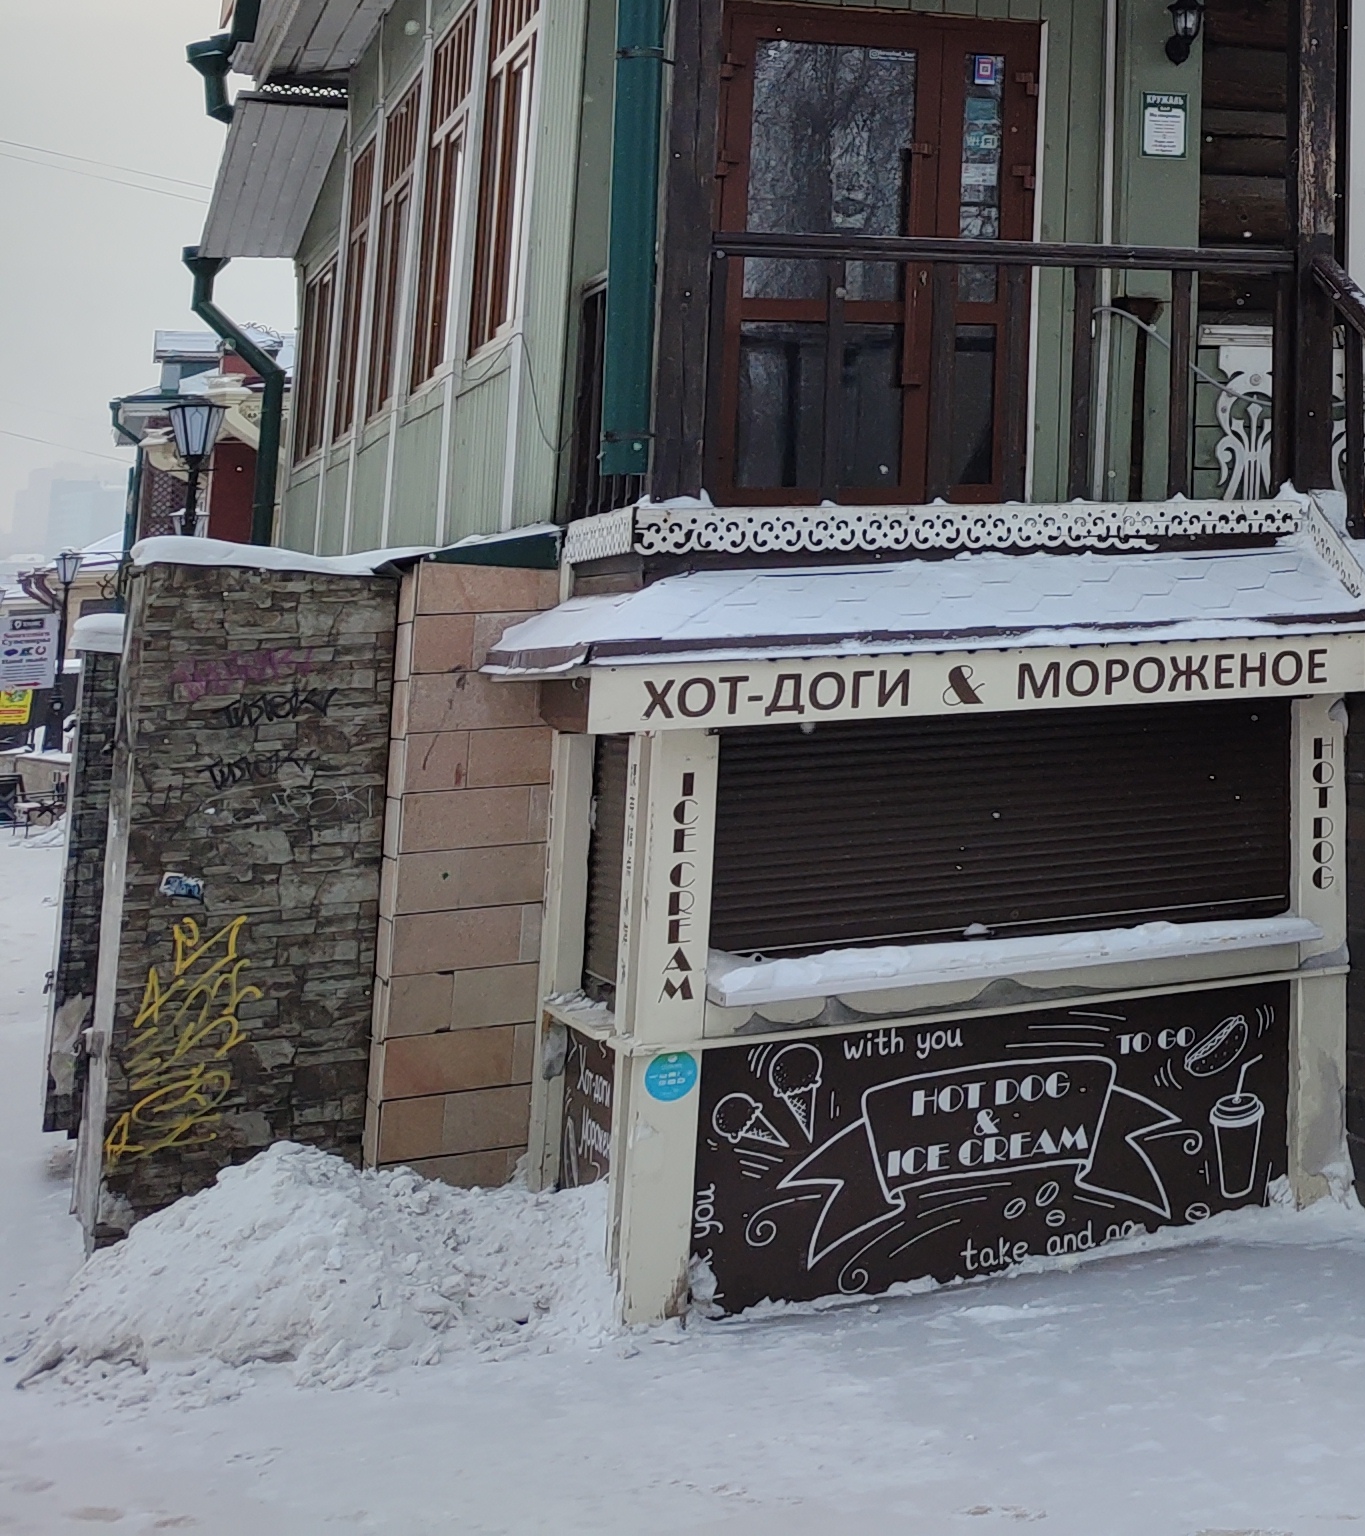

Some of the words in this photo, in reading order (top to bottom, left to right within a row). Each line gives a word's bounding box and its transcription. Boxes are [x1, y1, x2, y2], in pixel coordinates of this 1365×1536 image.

[641, 668, 909, 722] ХОТ-ДОГИ
[942, 664, 985, 706] &
[1017, 648, 1329, 701] МОРОЖЕНОЕ
[1312, 737, 1334, 808] HOT
[673, 771, 699, 853] ICE
[1312, 816, 1334, 890] DOG
[658, 861, 695, 1003] CREAM
[843, 1027, 904, 1060] with
[916, 1027, 963, 1059] you
[1115, 1032, 1151, 1055] TO
[1157, 1026, 1195, 1050] GO
[911, 1081, 985, 1116] HOT
[995, 1071, 1070, 1106] DOG
[974, 1109, 1001, 1136] &
[887, 1144, 950, 1177] ICE
[958, 1124, 1089, 1164] CREAM
[960, 1236, 1028, 1271] take
[1047, 1219, 1096, 1257] and
